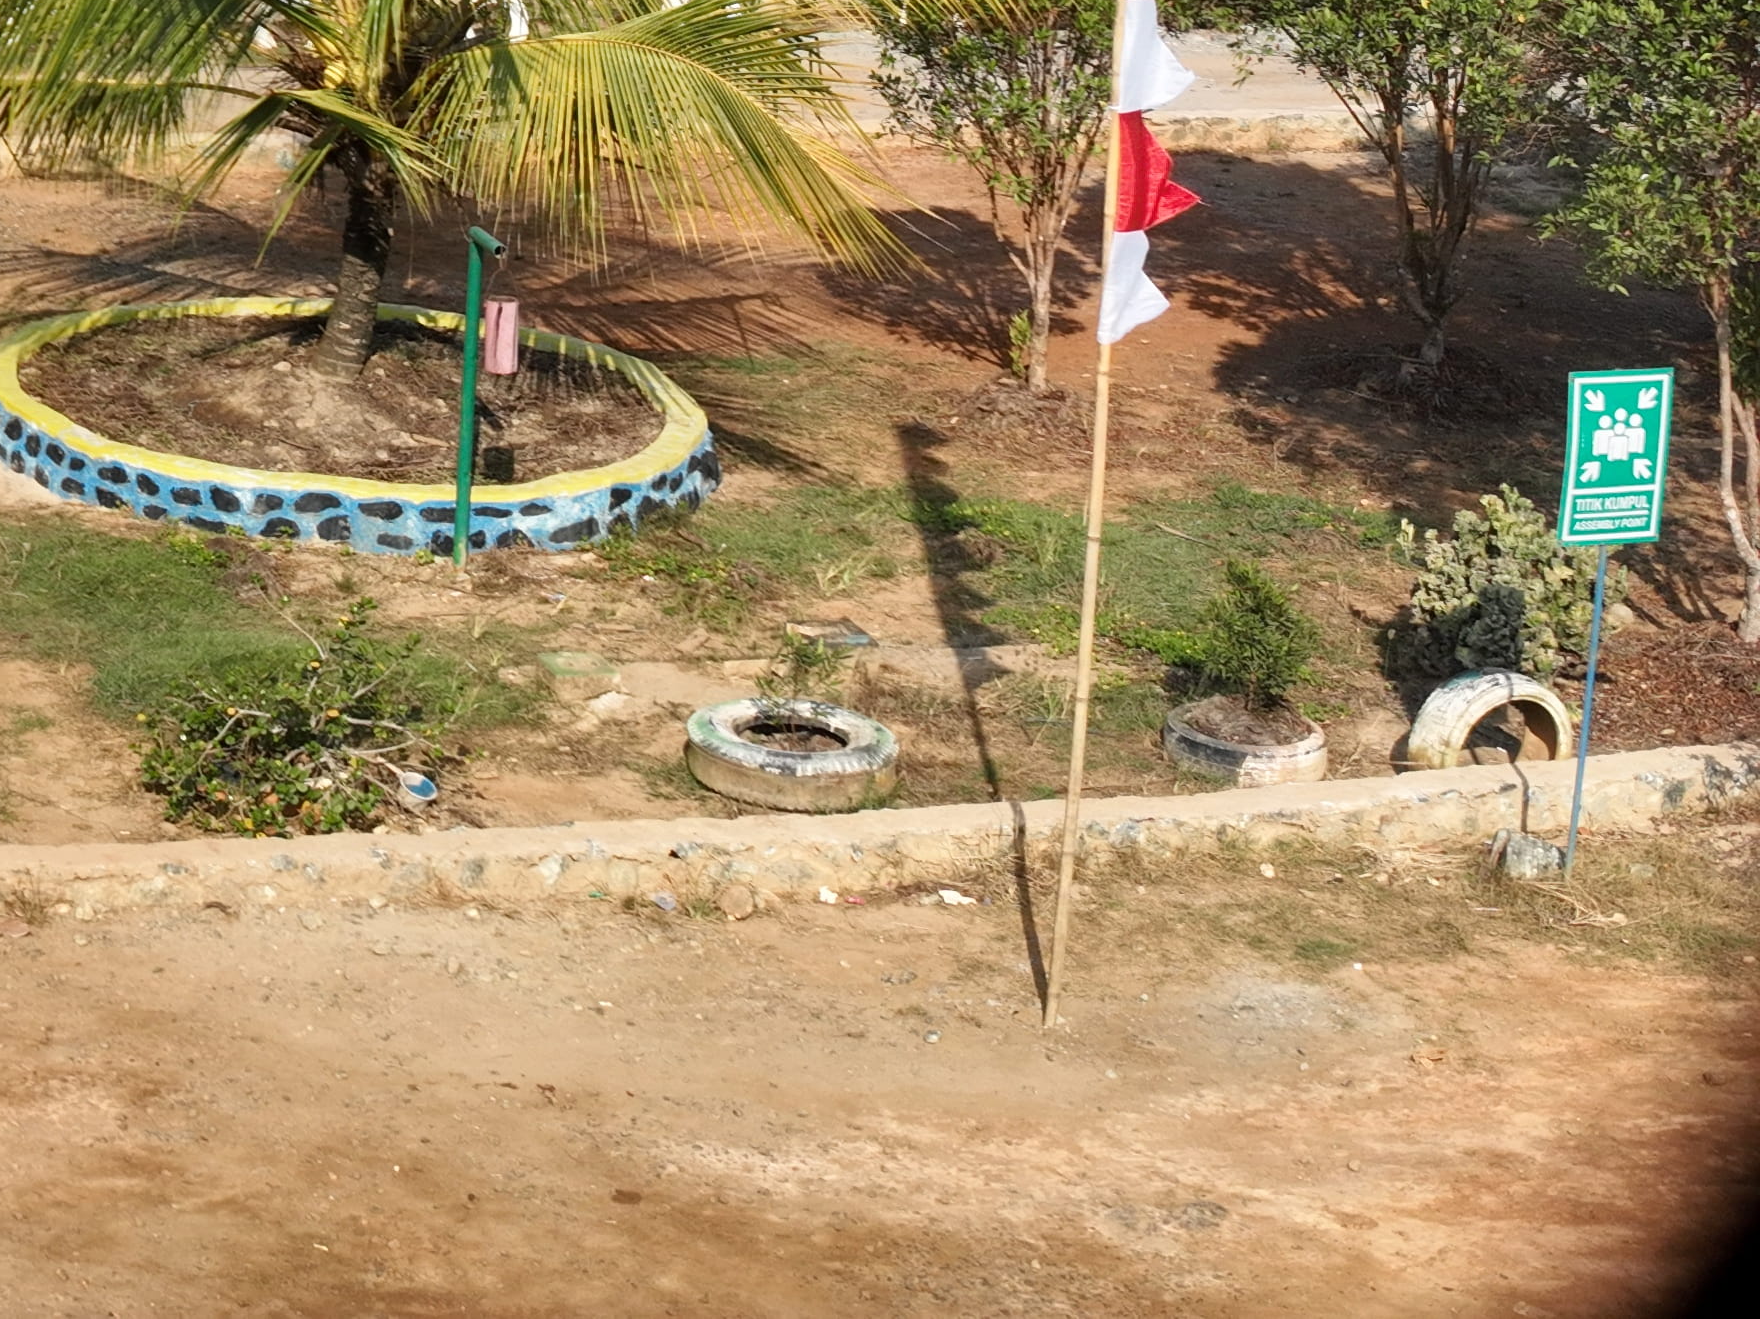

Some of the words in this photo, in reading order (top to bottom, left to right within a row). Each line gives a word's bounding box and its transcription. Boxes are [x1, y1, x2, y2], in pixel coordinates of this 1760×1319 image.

[1575, 497, 1603, 511] TITIK
[1604, 495, 1650, 509] KUMPUL
[1573, 519, 1620, 531] ASSEMBLY
[1620, 517, 1648, 528] POINT
